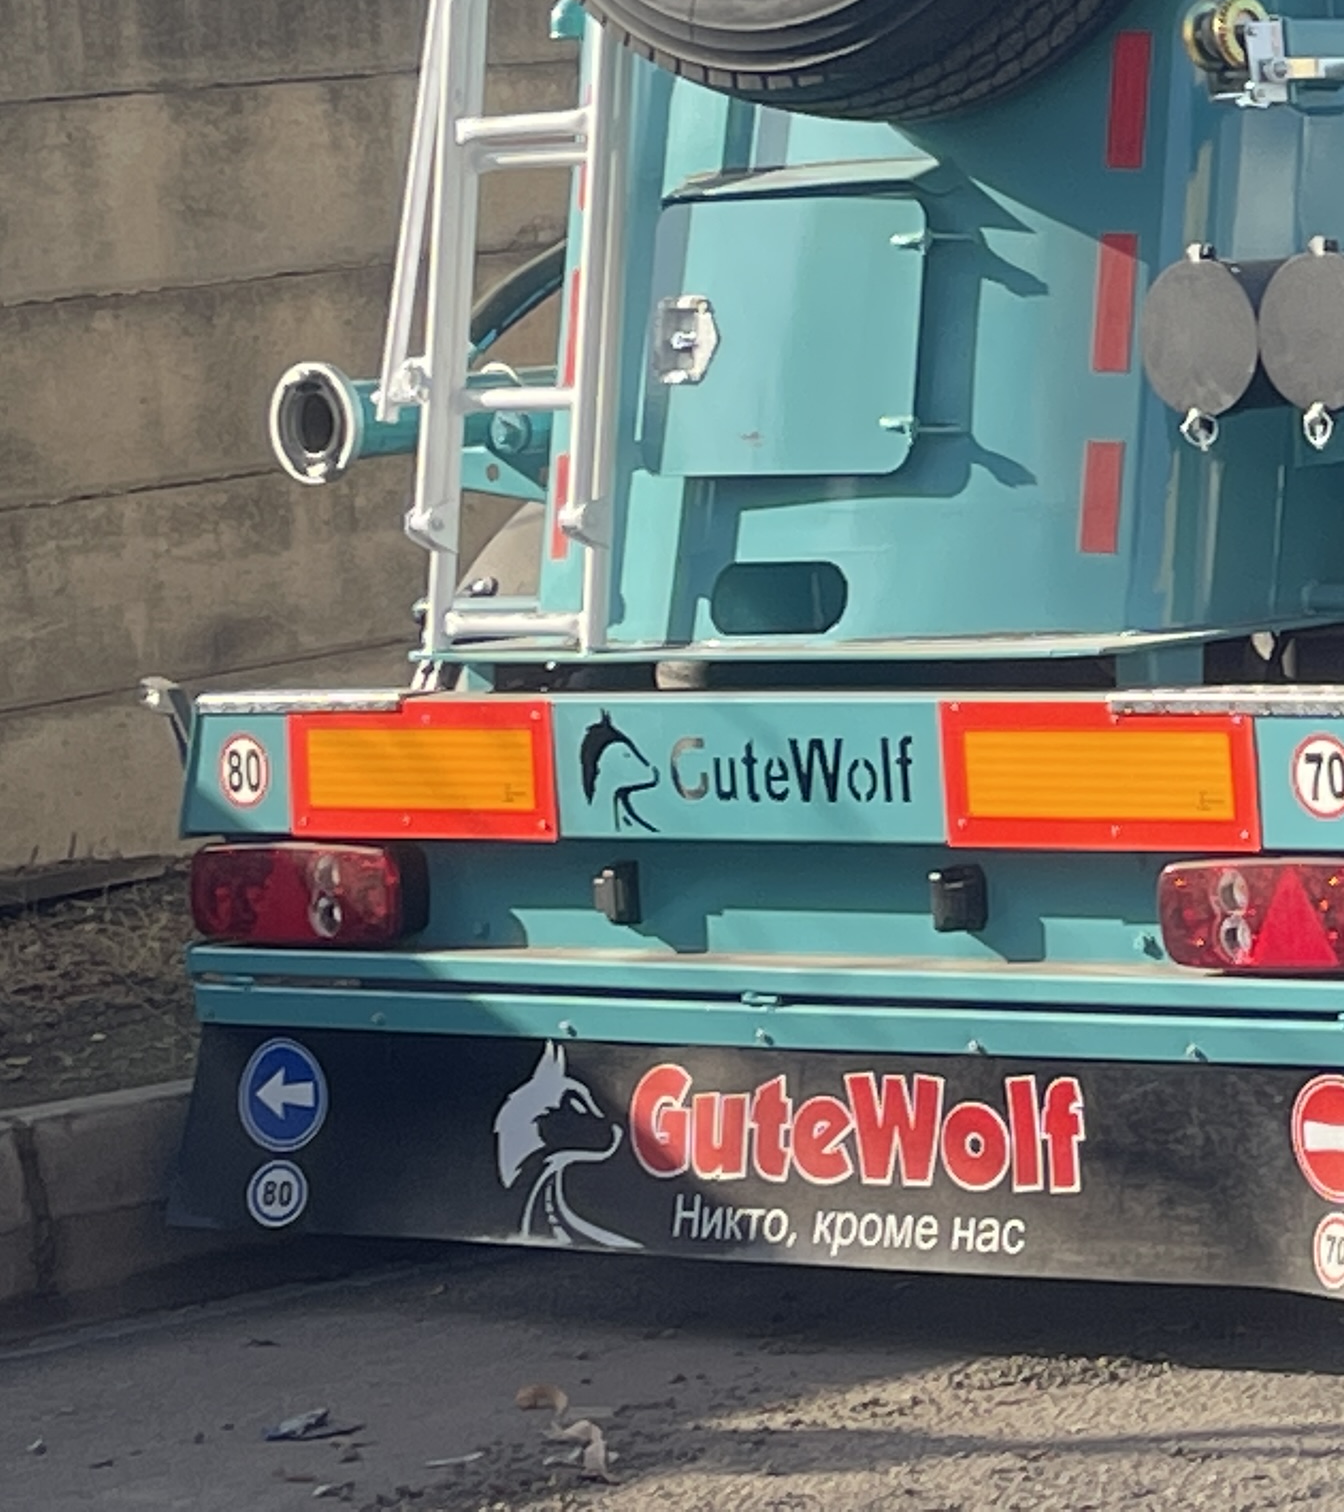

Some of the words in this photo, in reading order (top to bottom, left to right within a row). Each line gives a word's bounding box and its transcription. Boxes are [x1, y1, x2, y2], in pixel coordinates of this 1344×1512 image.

[227, 749, 261, 793] 80
[630, 1063, 1085, 1195] GuteWolf
[263, 1180, 293, 1208] 80
[671, 1192, 799, 1248] Никто,
[812, 1207, 939, 1257] кроме
[950, 1214, 1027, 1255] нас
